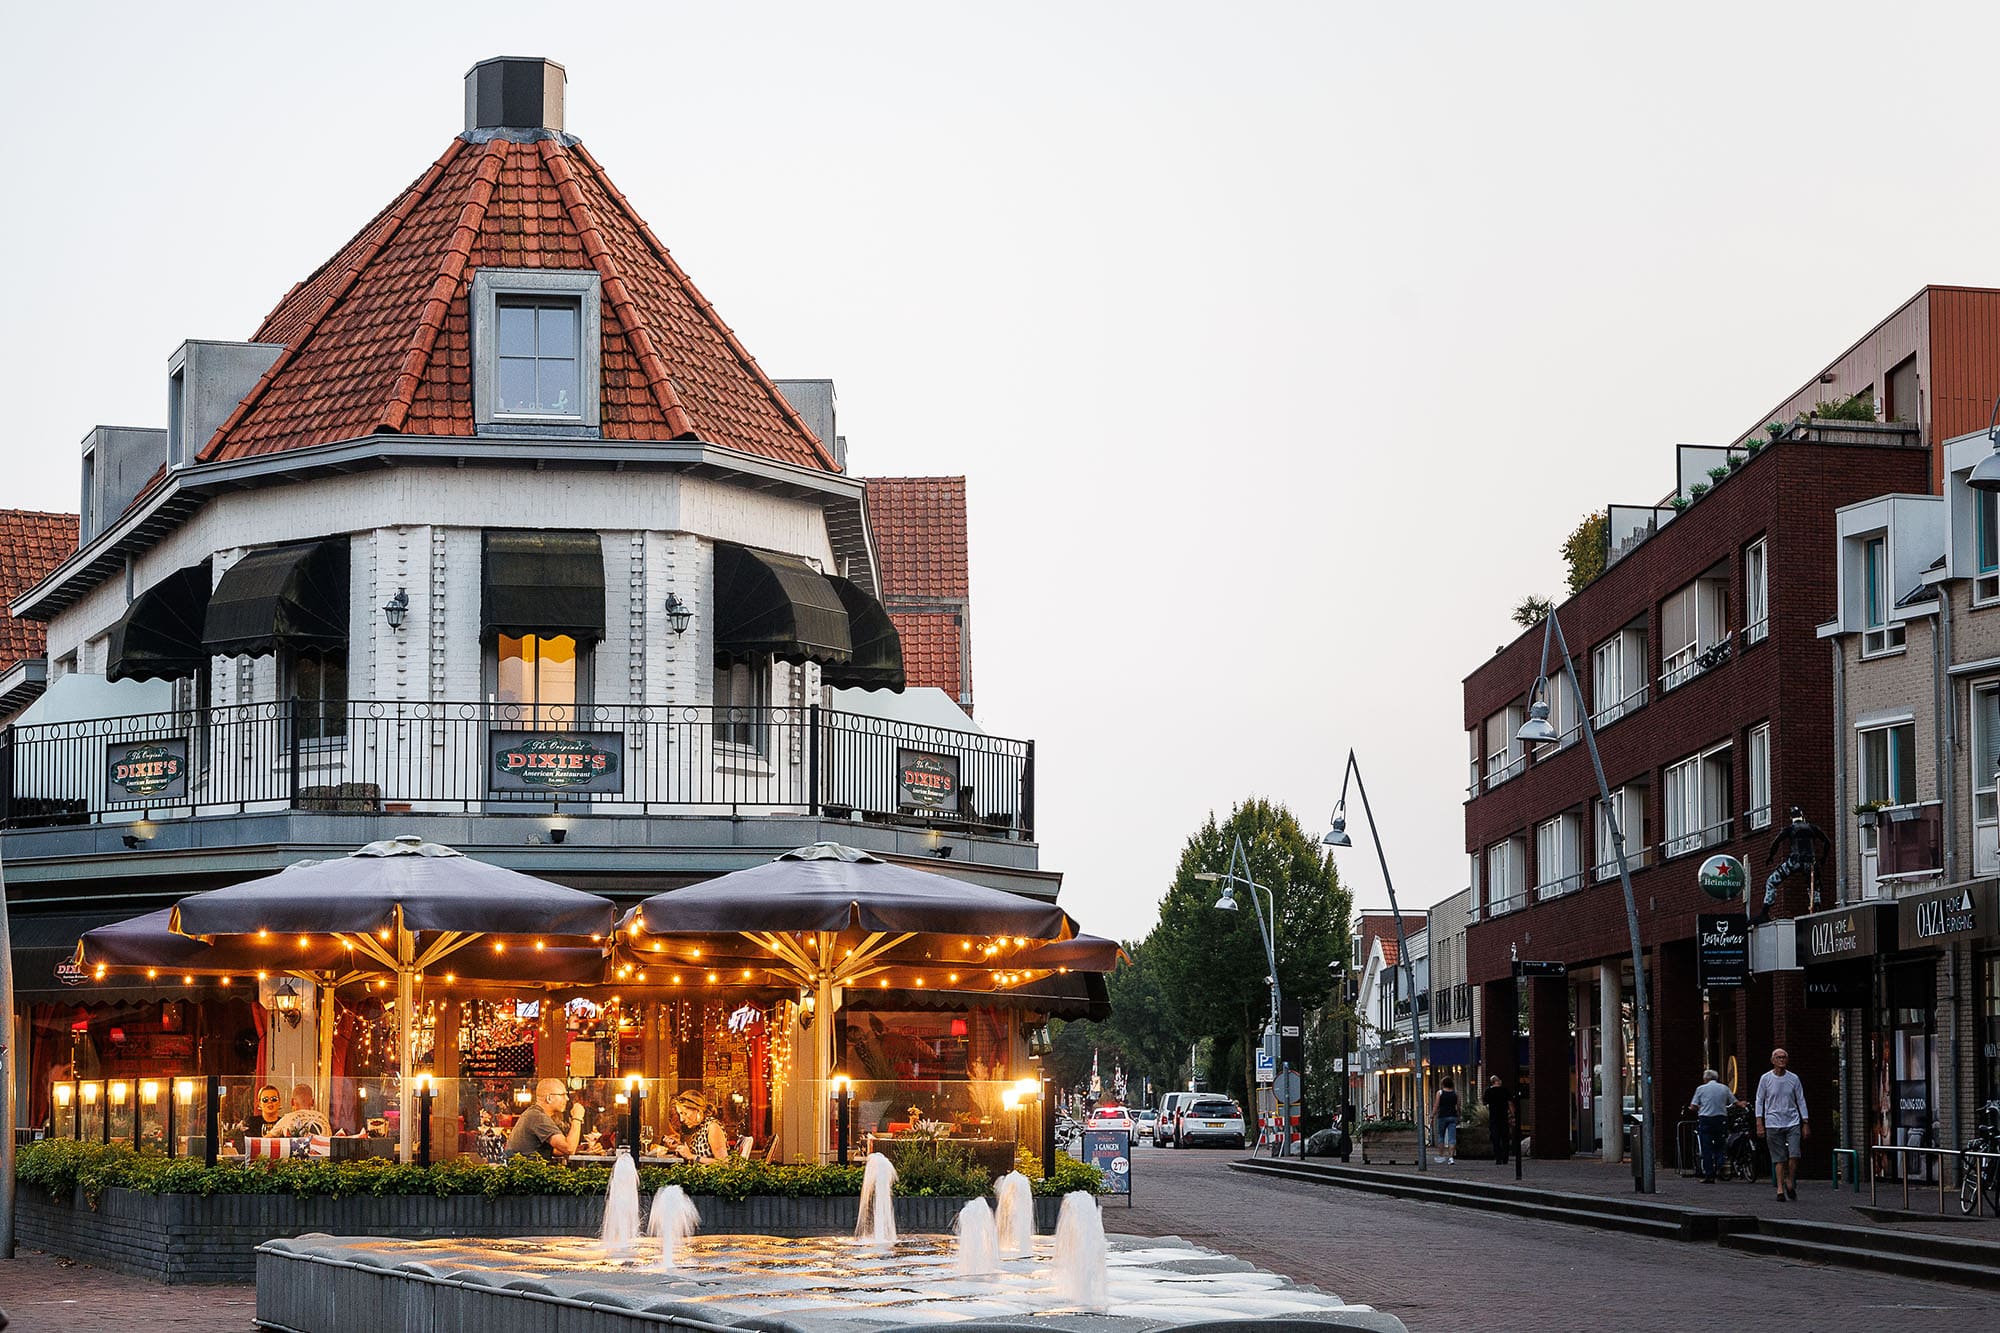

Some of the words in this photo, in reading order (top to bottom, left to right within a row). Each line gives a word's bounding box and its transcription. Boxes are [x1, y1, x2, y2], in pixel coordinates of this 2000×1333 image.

[532, 741, 546, 750] The
[549, 742, 584, 752] Original
[117, 760, 177, 778] DIXIE'S
[507, 753, 606, 769] DIXIE'S
[555, 769, 590, 777] Restaurant
[905, 770, 951, 790] DIXIE'S
[1917, 899, 1945, 938] OAZA
[1812, 923, 1834, 956] OAZA
[1809, 983, 1837, 992] OAZA
